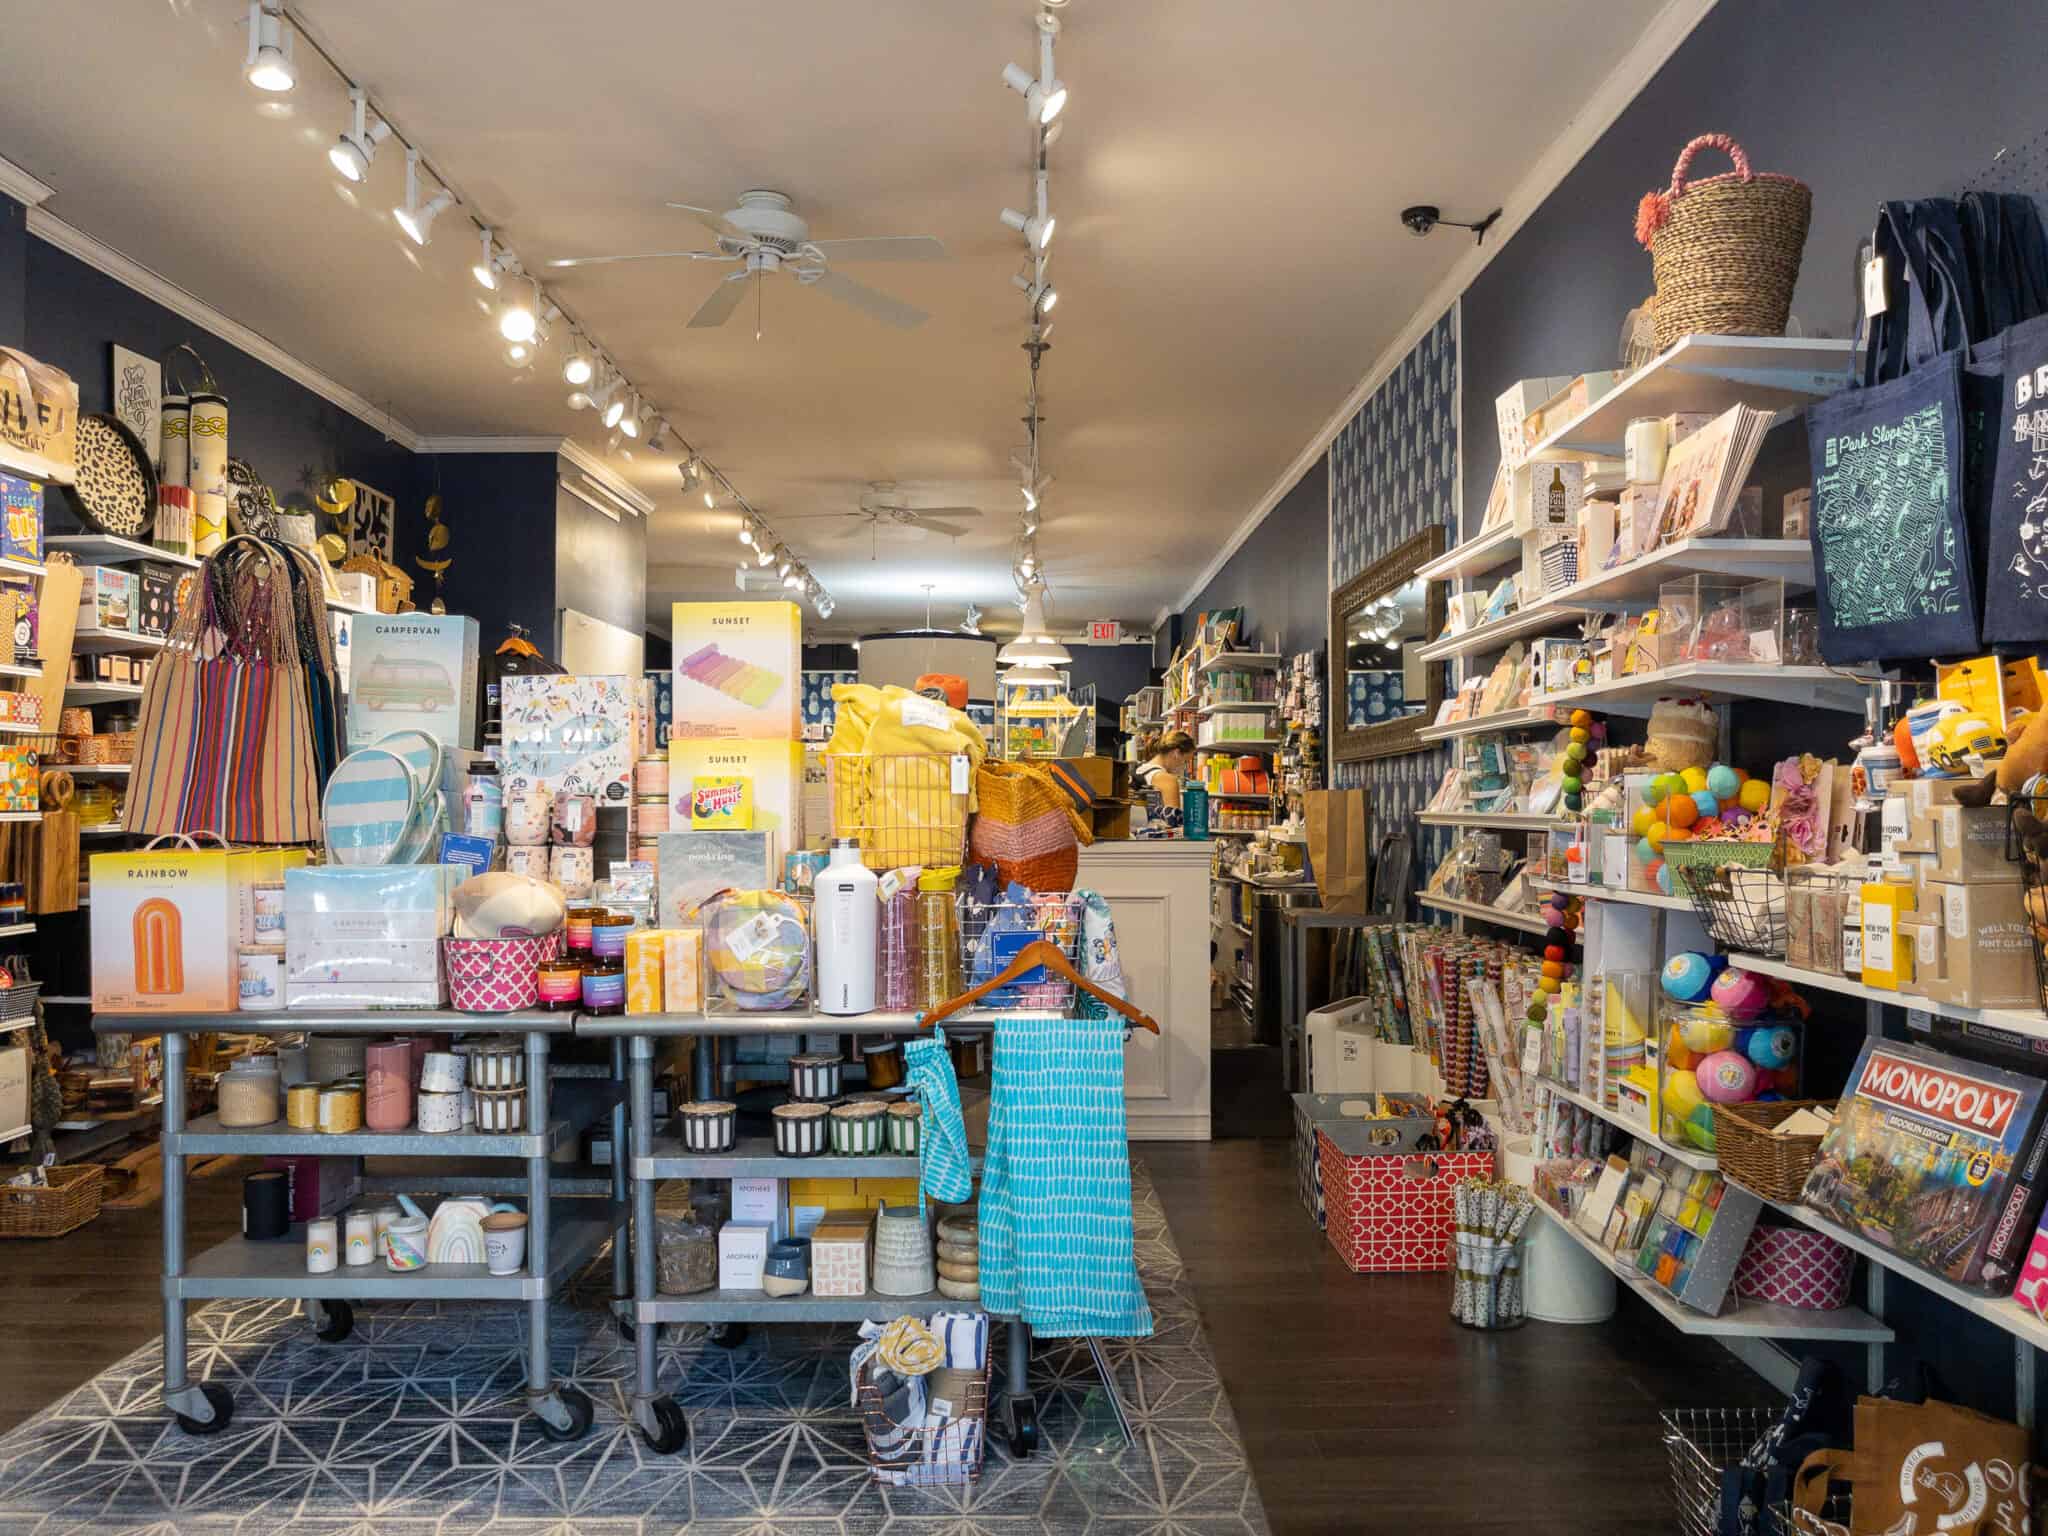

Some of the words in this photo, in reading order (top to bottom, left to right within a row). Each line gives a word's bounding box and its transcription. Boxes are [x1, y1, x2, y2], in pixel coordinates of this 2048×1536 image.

[1840, 432, 1870, 454] Park
[376, 625, 440, 635] CAMPERVAN
[712, 617, 750, 625] SUNSET
[1093, 623, 1116, 640] EXIT
[708, 755, 747, 764] SUNSET
[697, 785, 738, 804] Summer
[712, 791, 743, 811] Music
[127, 869, 189, 879] RAINBOW
[1864, 1062, 2012, 1129] MONOPOLY
[1890, 1115, 1923, 1137] BROOKLYN
[1922, 1125, 1950, 1145] EDITION
[1990, 1187, 2025, 1257] MONOPOLY
